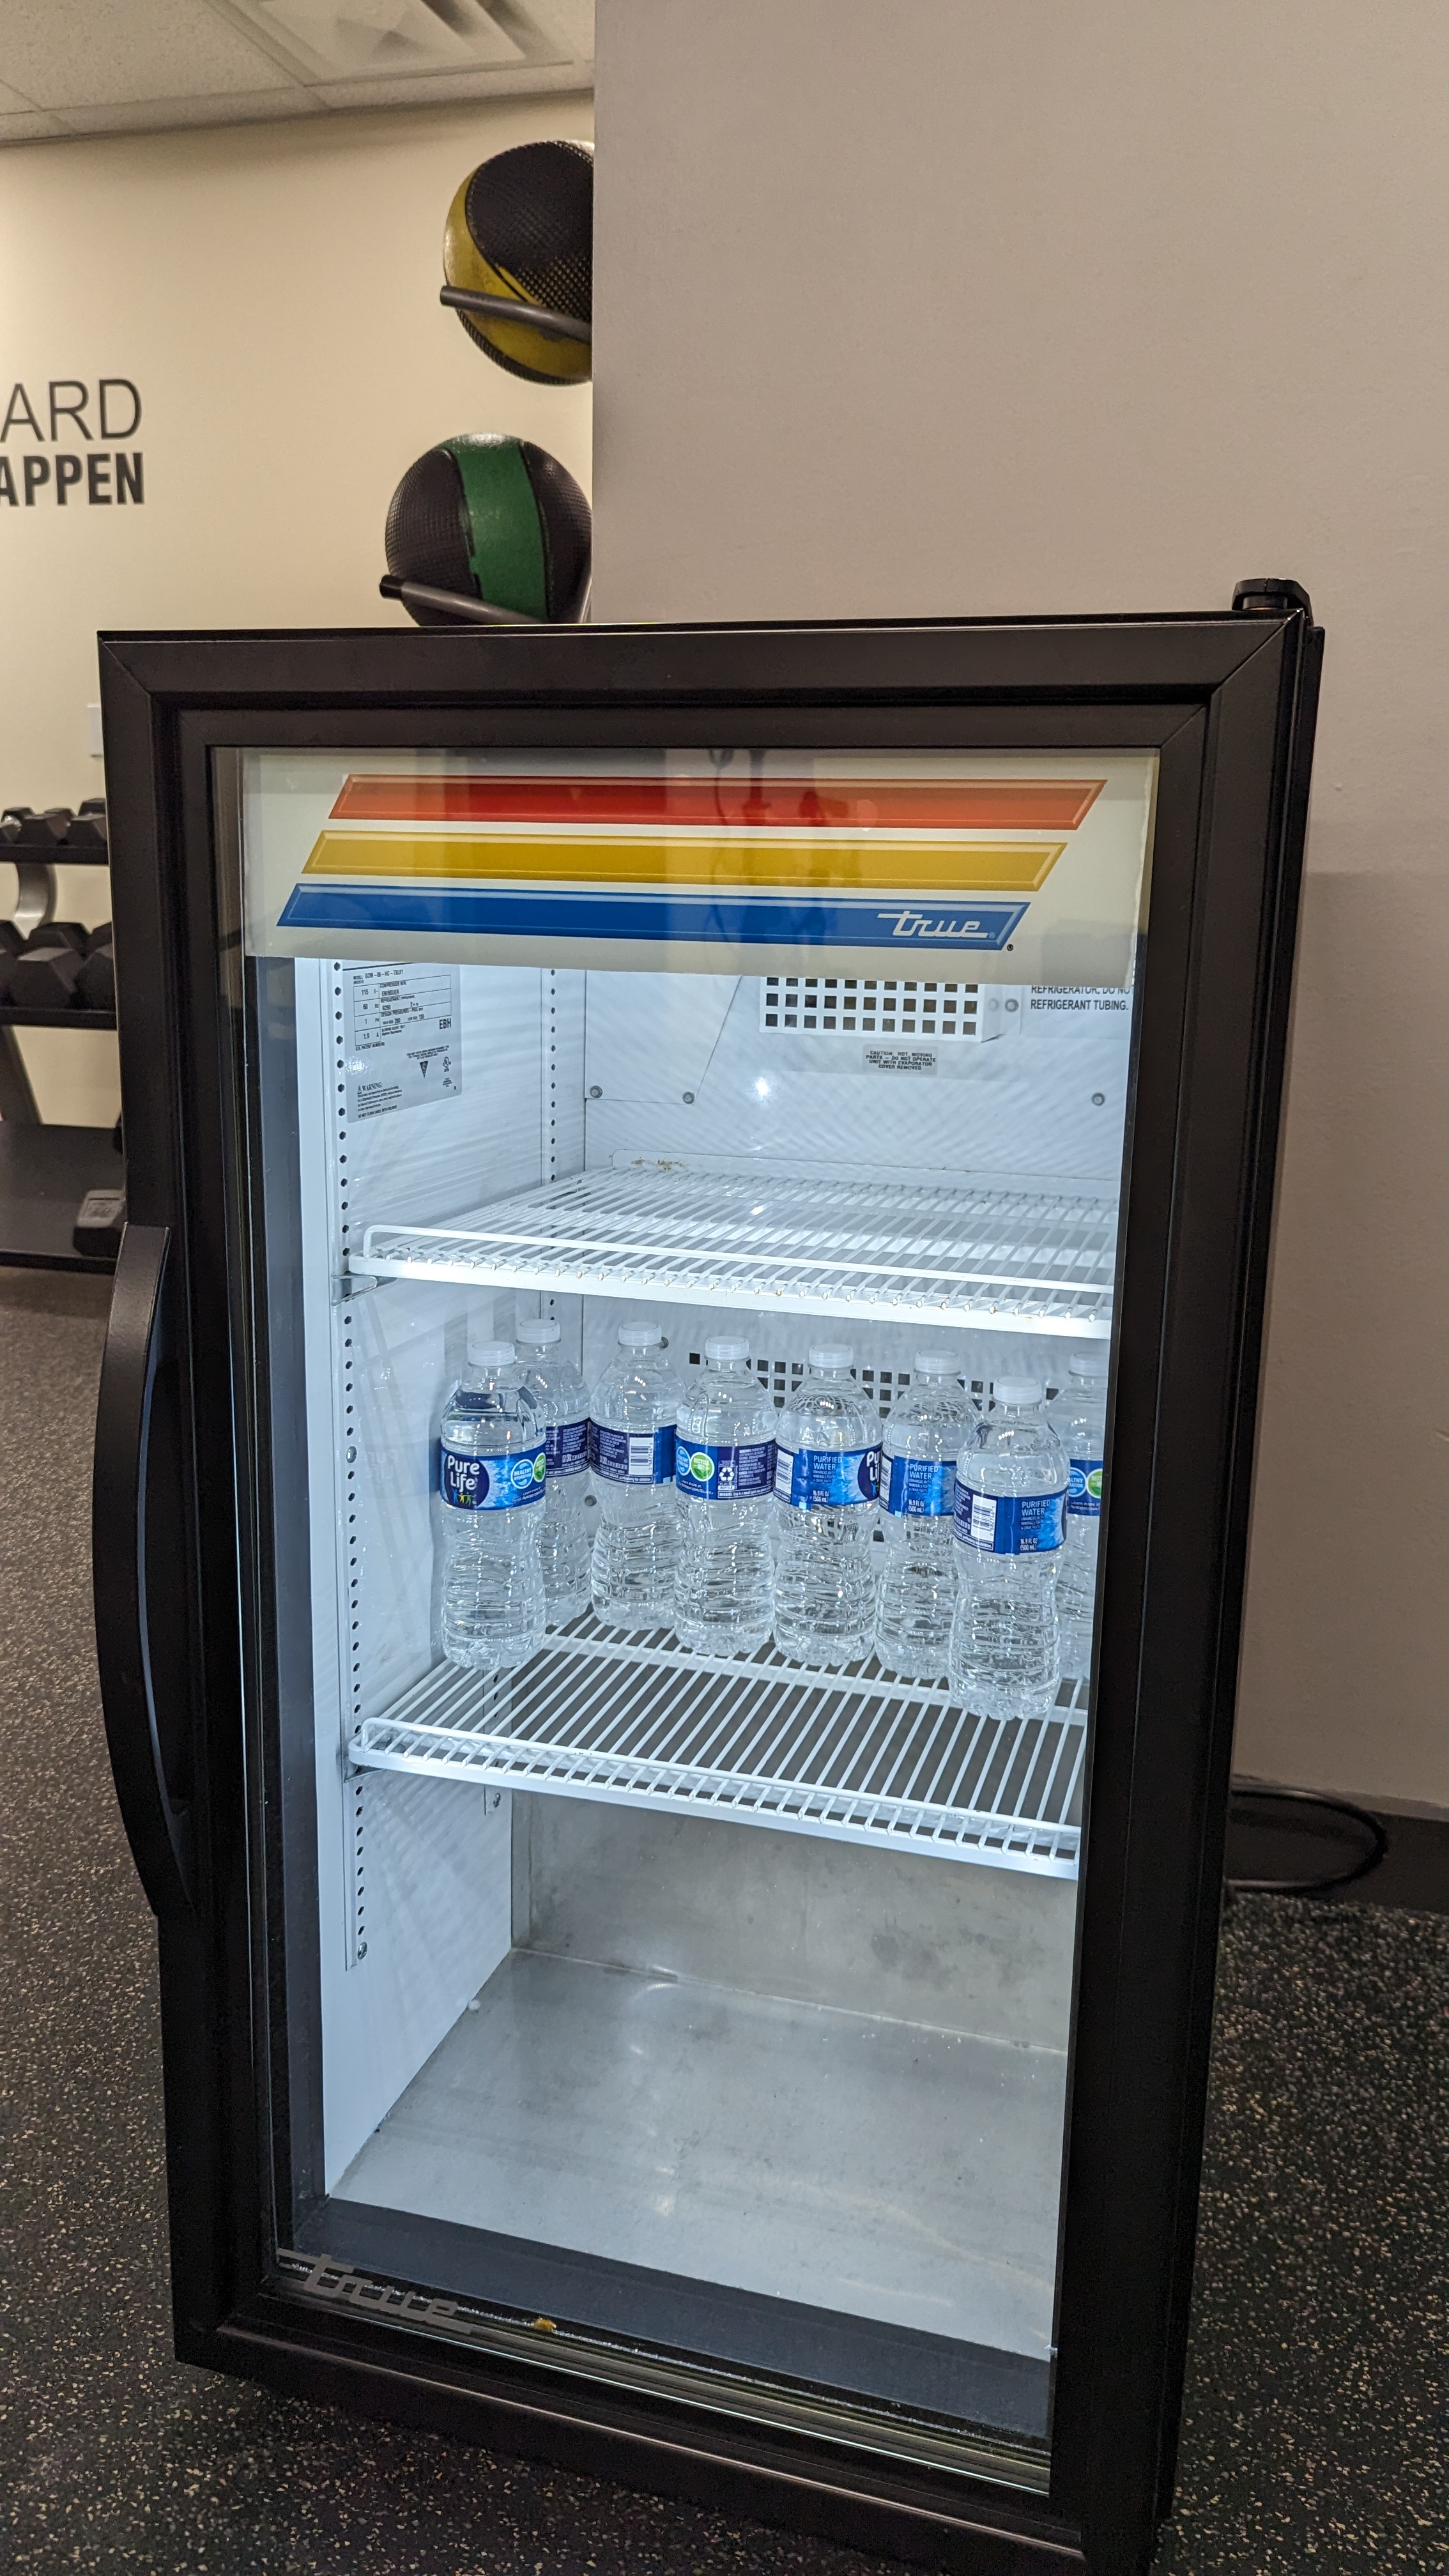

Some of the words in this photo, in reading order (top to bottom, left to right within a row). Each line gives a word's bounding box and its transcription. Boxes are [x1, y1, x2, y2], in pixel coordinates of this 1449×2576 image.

[0, 378, 142, 443] ARD
[877, 910, 989, 939] true
[1031, 999, 1091, 1010] REFRIGERANT
[1093, 1000, 1129, 1011] TUBING.
[439, 1018, 452, 1030] EBH
[447, 1455, 480, 1475] Pure
[813, 1455, 843, 1463] PURIFIED
[866, 1451, 880, 1468] Pu
[813, 1462, 836, 1471] WATER
[909, 1463, 939, 1473] PURIFIED
[450, 1471, 477, 1492] Life
[909, 1471, 932, 1480] WATER
[1022, 1499, 1051, 1508] PURIFIED
[1021, 1508, 1045, 1517] WATER
[275, 2247, 475, 2335] true
